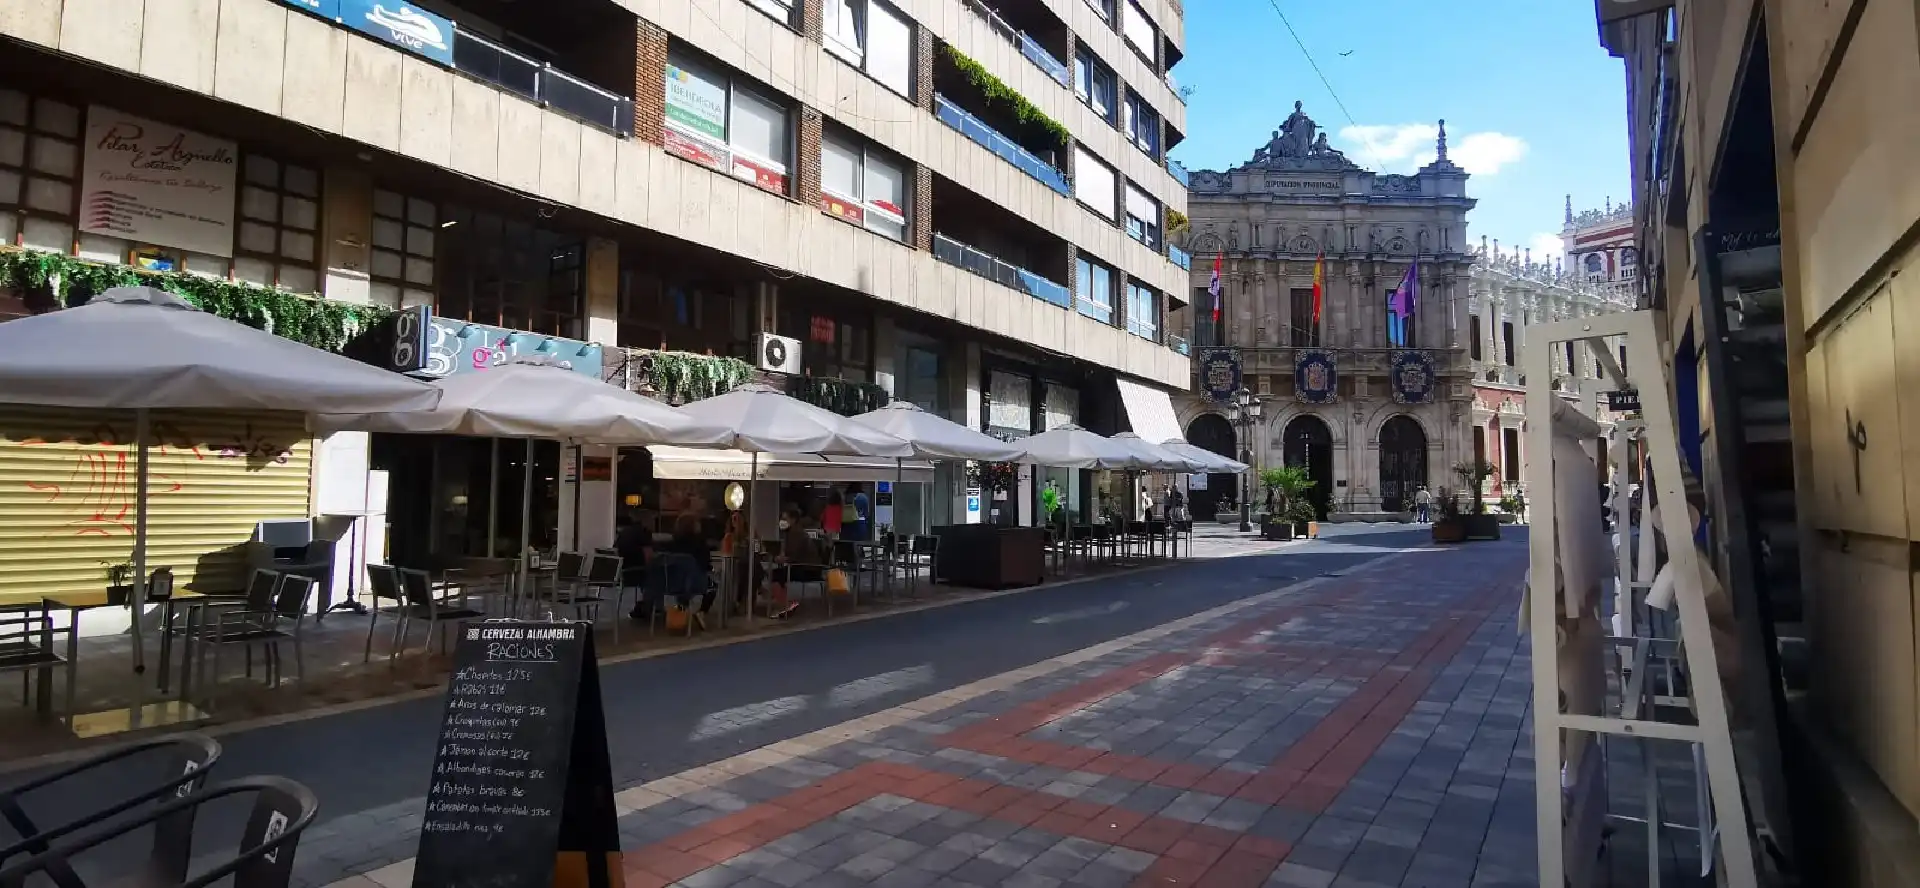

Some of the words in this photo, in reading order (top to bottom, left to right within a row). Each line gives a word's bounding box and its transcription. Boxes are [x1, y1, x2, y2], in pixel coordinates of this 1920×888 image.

[481, 628, 524, 639] CERVEZAS
[526, 629, 575, 640] ALHAMBRA
[486, 642, 554, 660] RACIONES
